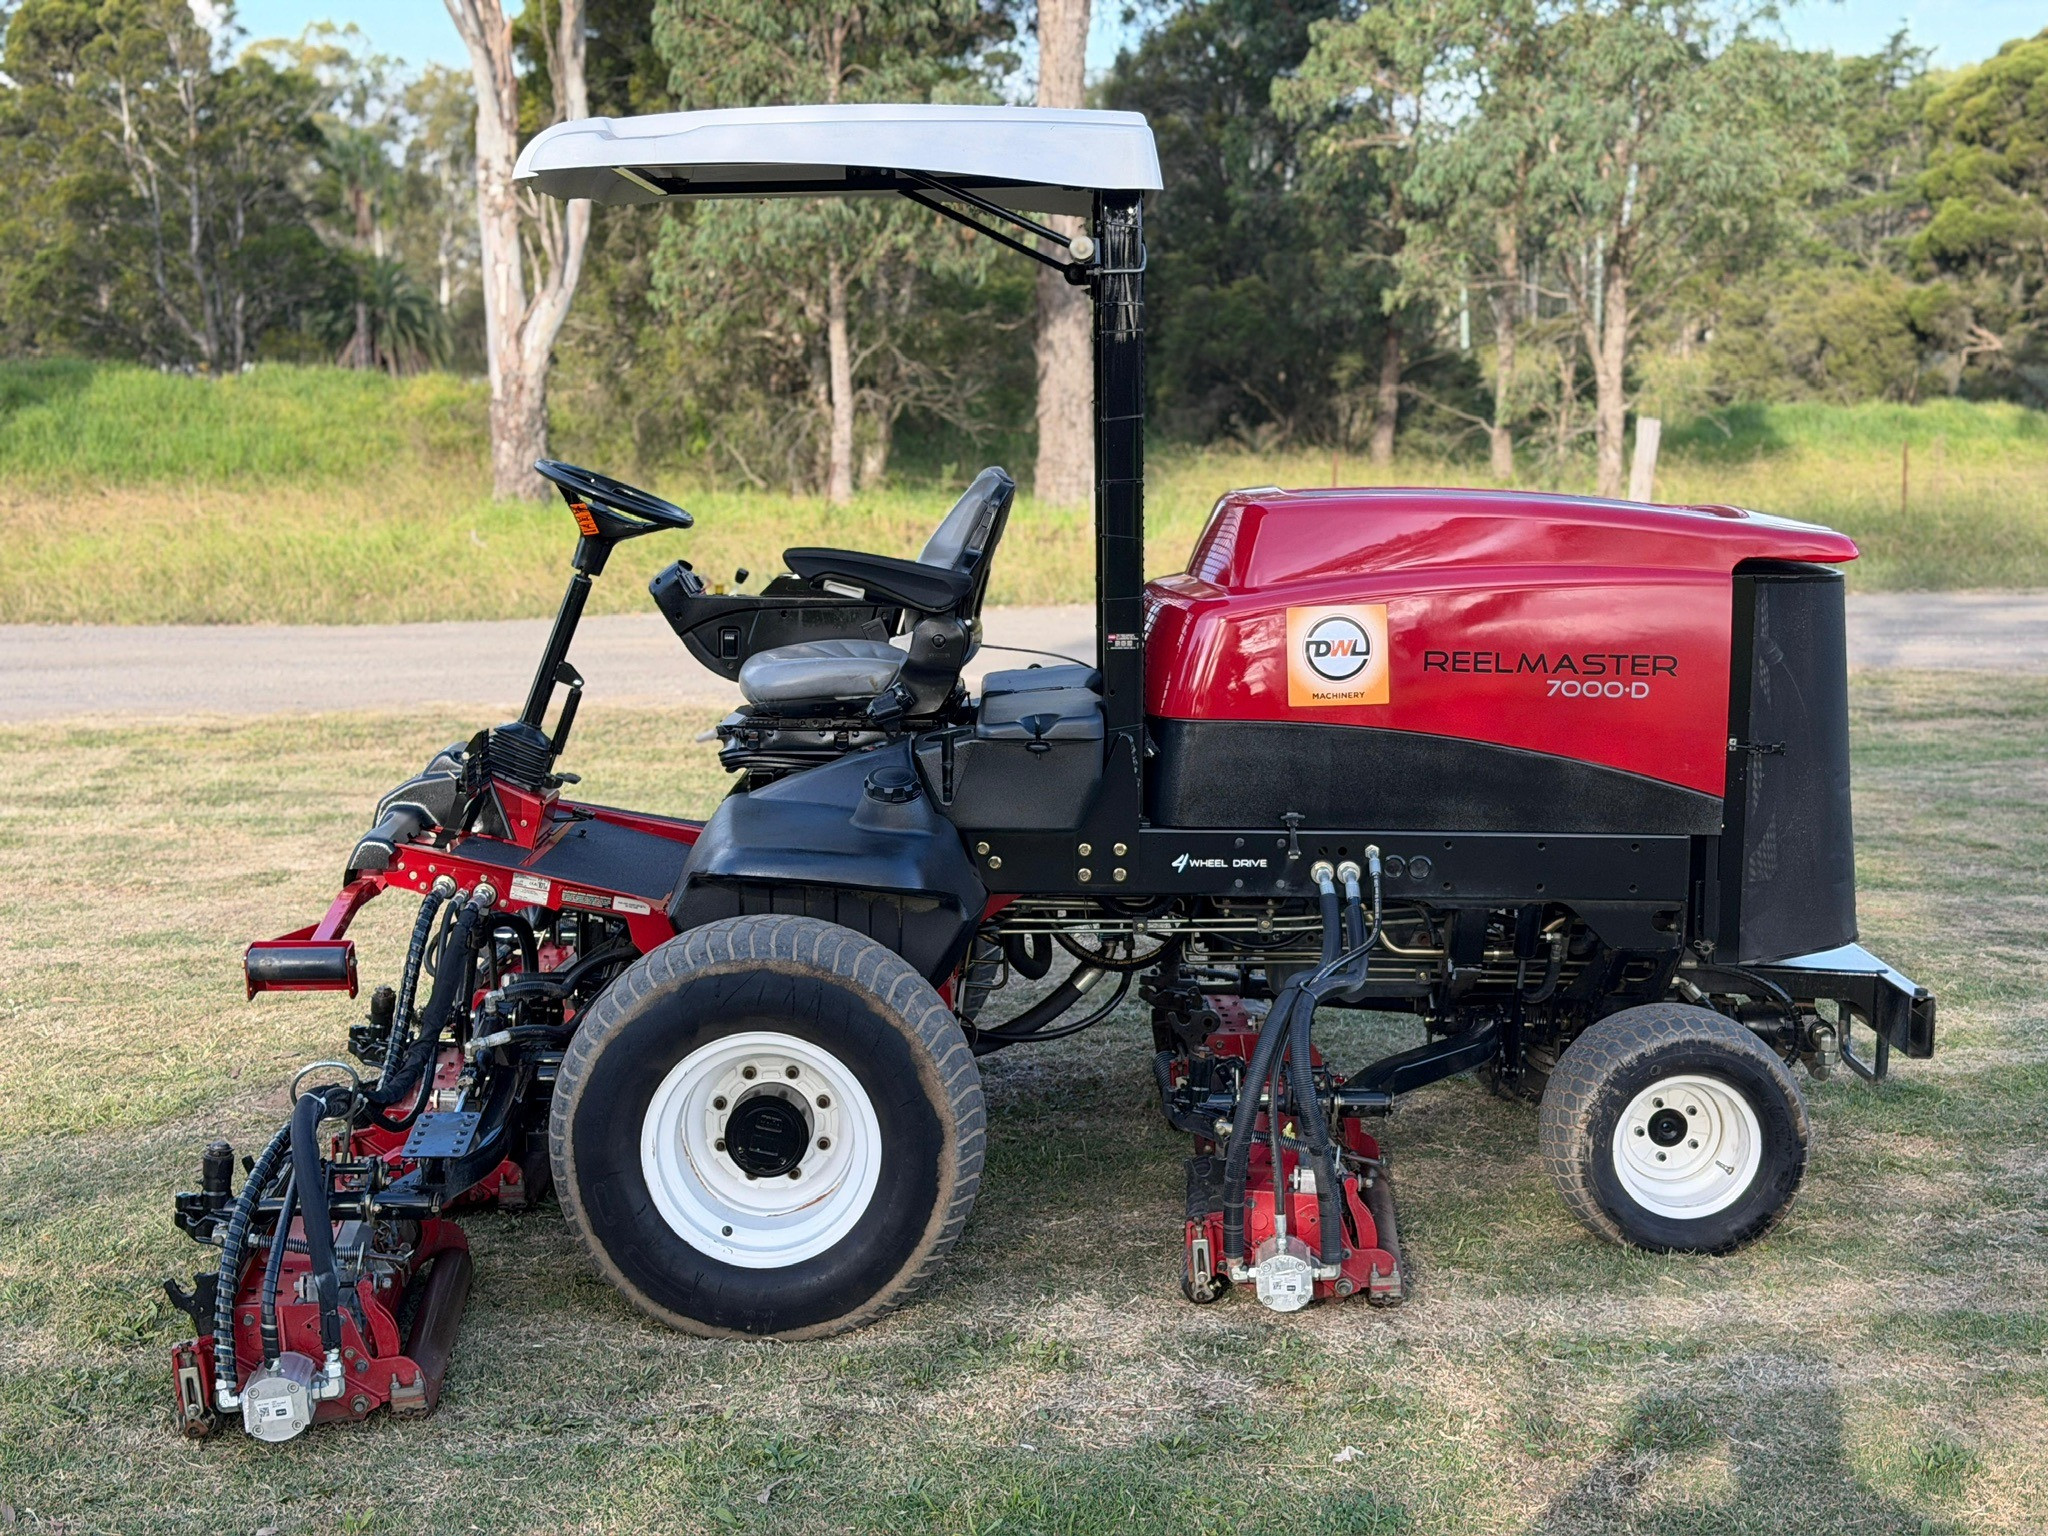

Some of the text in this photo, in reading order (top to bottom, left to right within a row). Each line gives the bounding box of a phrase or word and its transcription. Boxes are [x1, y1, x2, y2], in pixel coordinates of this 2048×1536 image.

[1305, 638, 1370, 658] DWL
[1423, 650, 1679, 678] REELMASTER
[1311, 691, 1366, 700] MACHINERY
[1171, 852, 1268, 874] 4 WHEEL DRIVE
